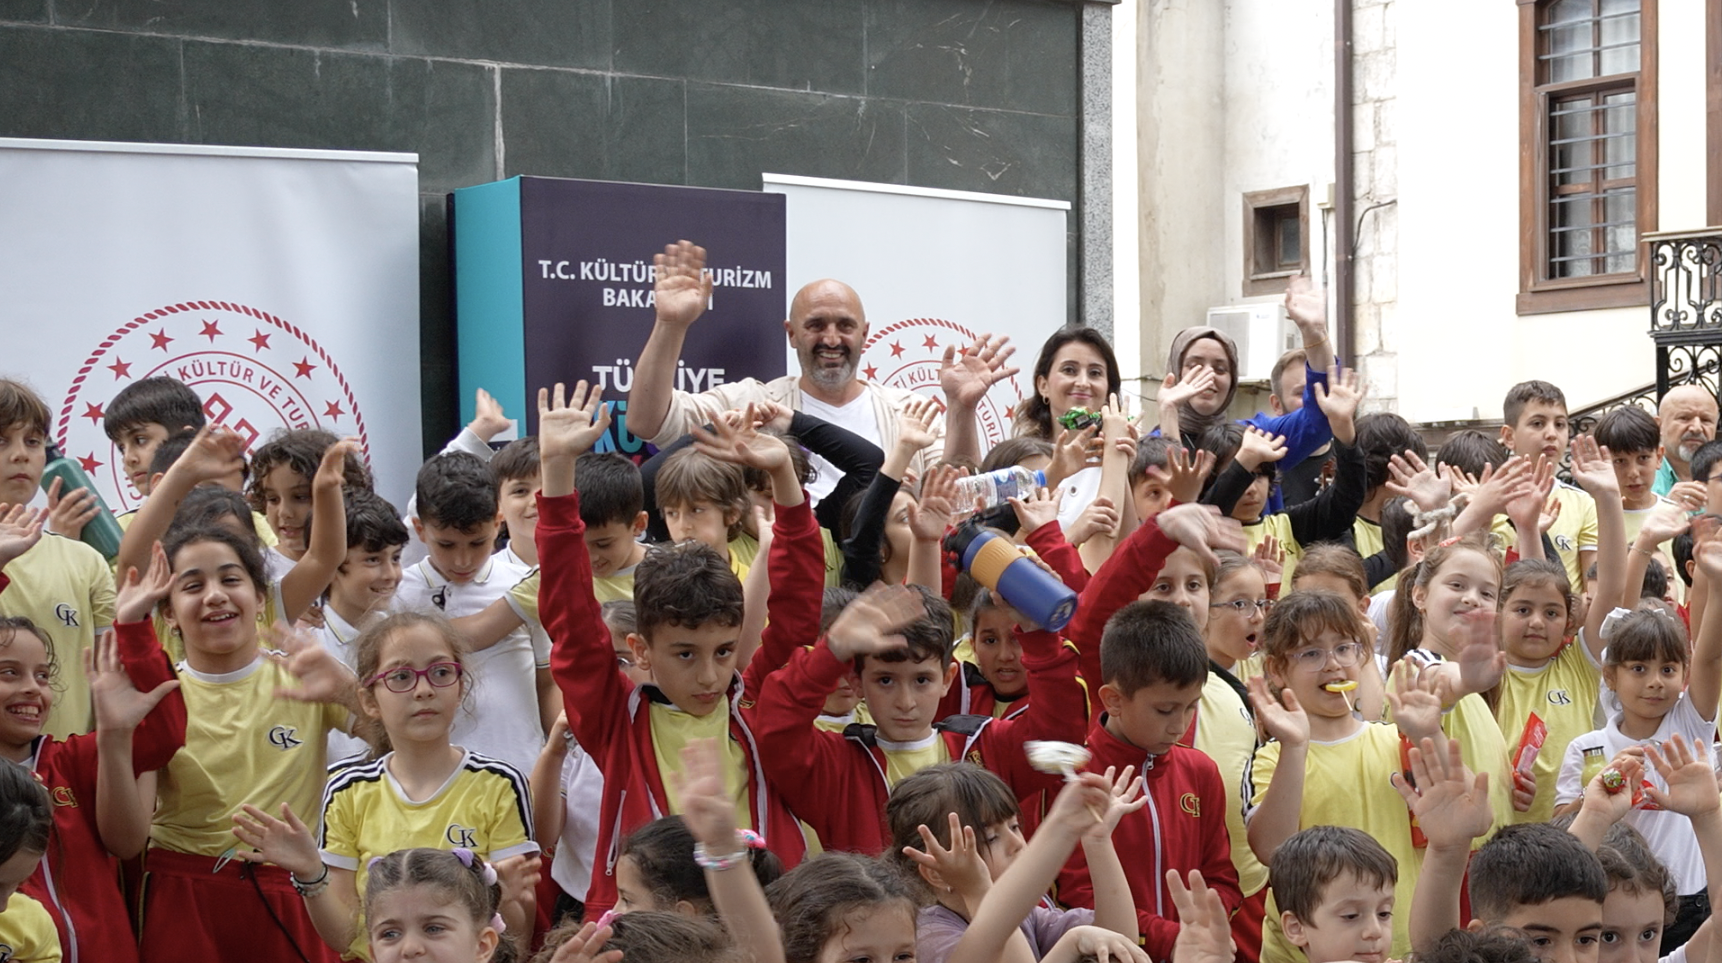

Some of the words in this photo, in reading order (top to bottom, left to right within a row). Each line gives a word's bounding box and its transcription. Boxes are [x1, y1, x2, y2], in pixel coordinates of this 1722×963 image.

[538, 259, 575, 280] T.C.
[580, 258, 658, 283] KÜLTÜR
[603, 288, 714, 310] BAKAI
[178, 360, 254, 383] KÜLTÜR
[259, 375, 282, 400] VE
[592, 359, 725, 393] TÜİYE
